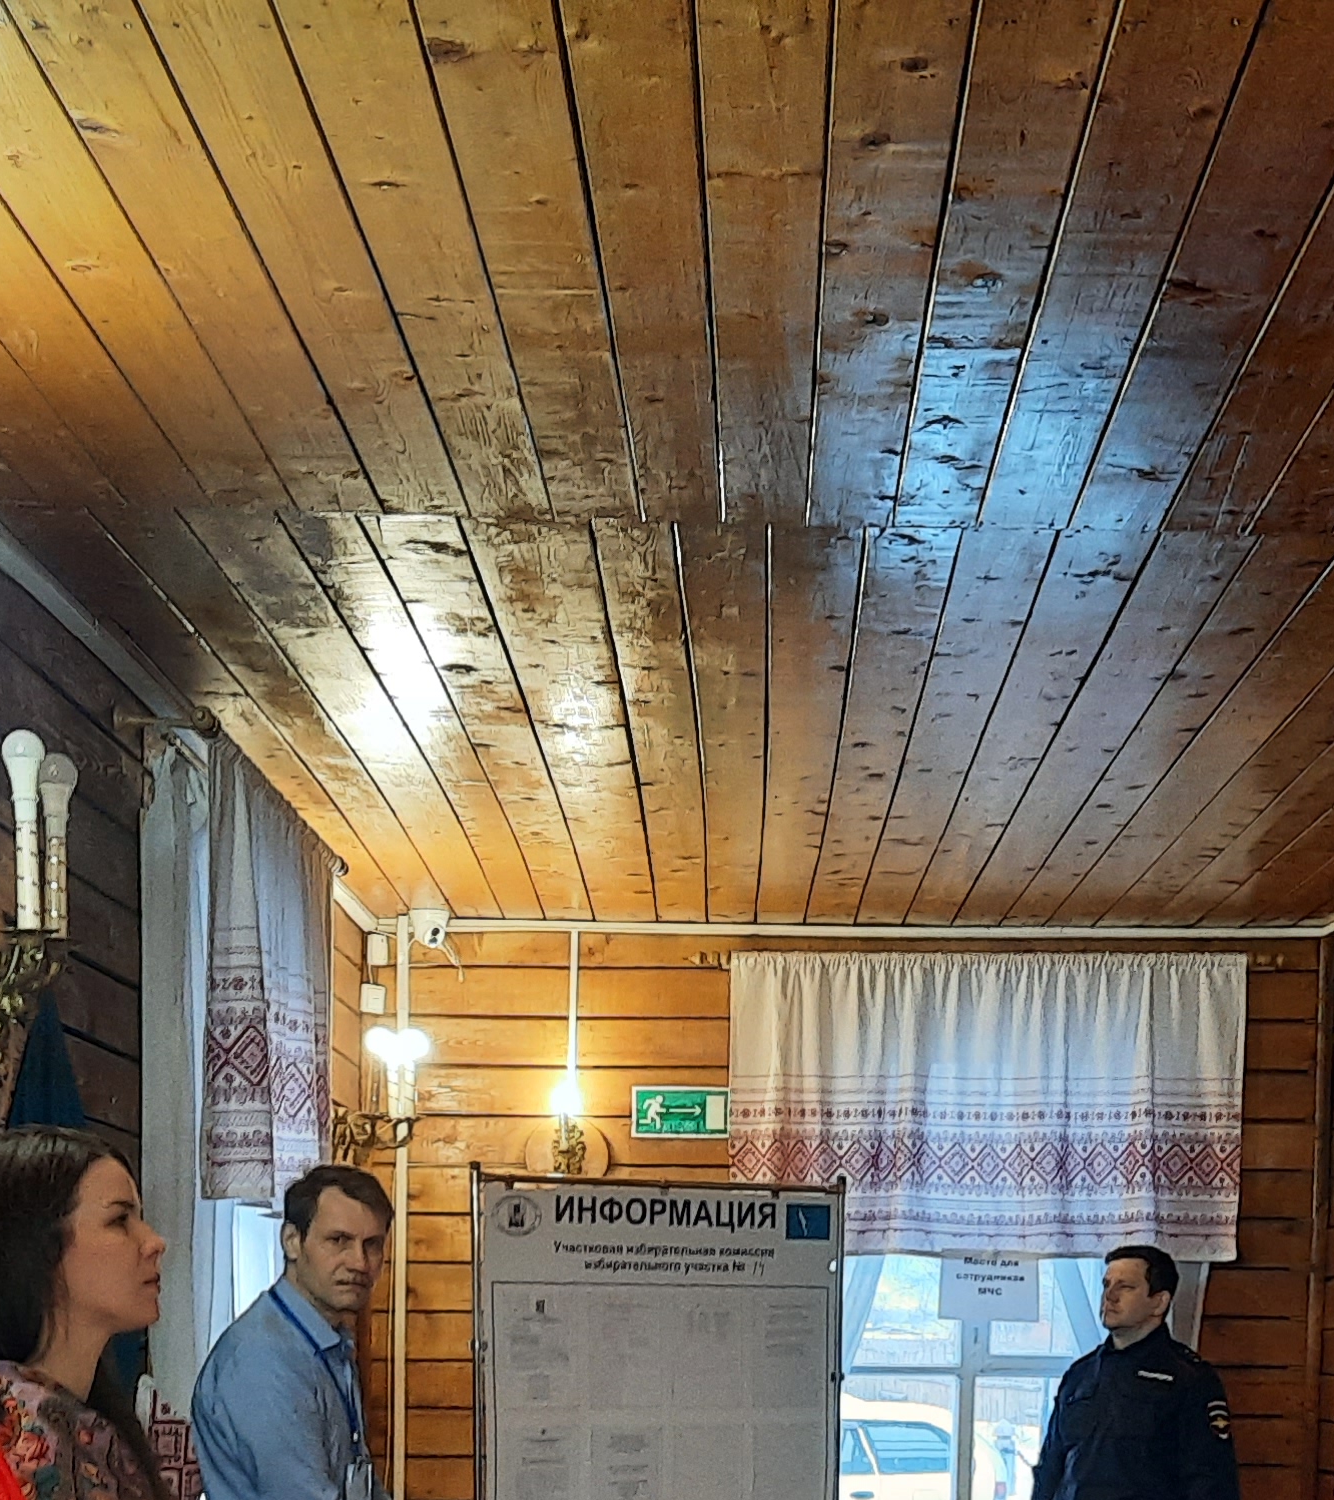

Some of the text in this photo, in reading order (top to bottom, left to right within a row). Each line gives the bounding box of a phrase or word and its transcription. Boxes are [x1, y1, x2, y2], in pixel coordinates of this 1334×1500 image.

[555, 1194, 777, 1234] ИНФОРМАЦИЯ
[554, 1240, 775, 1259] Участковая избирательная комиссия
[584, 1257, 682, 1274] избирательного
[685, 1262, 730, 1276] участка
[978, 1287, 1003, 1296] МЧС
